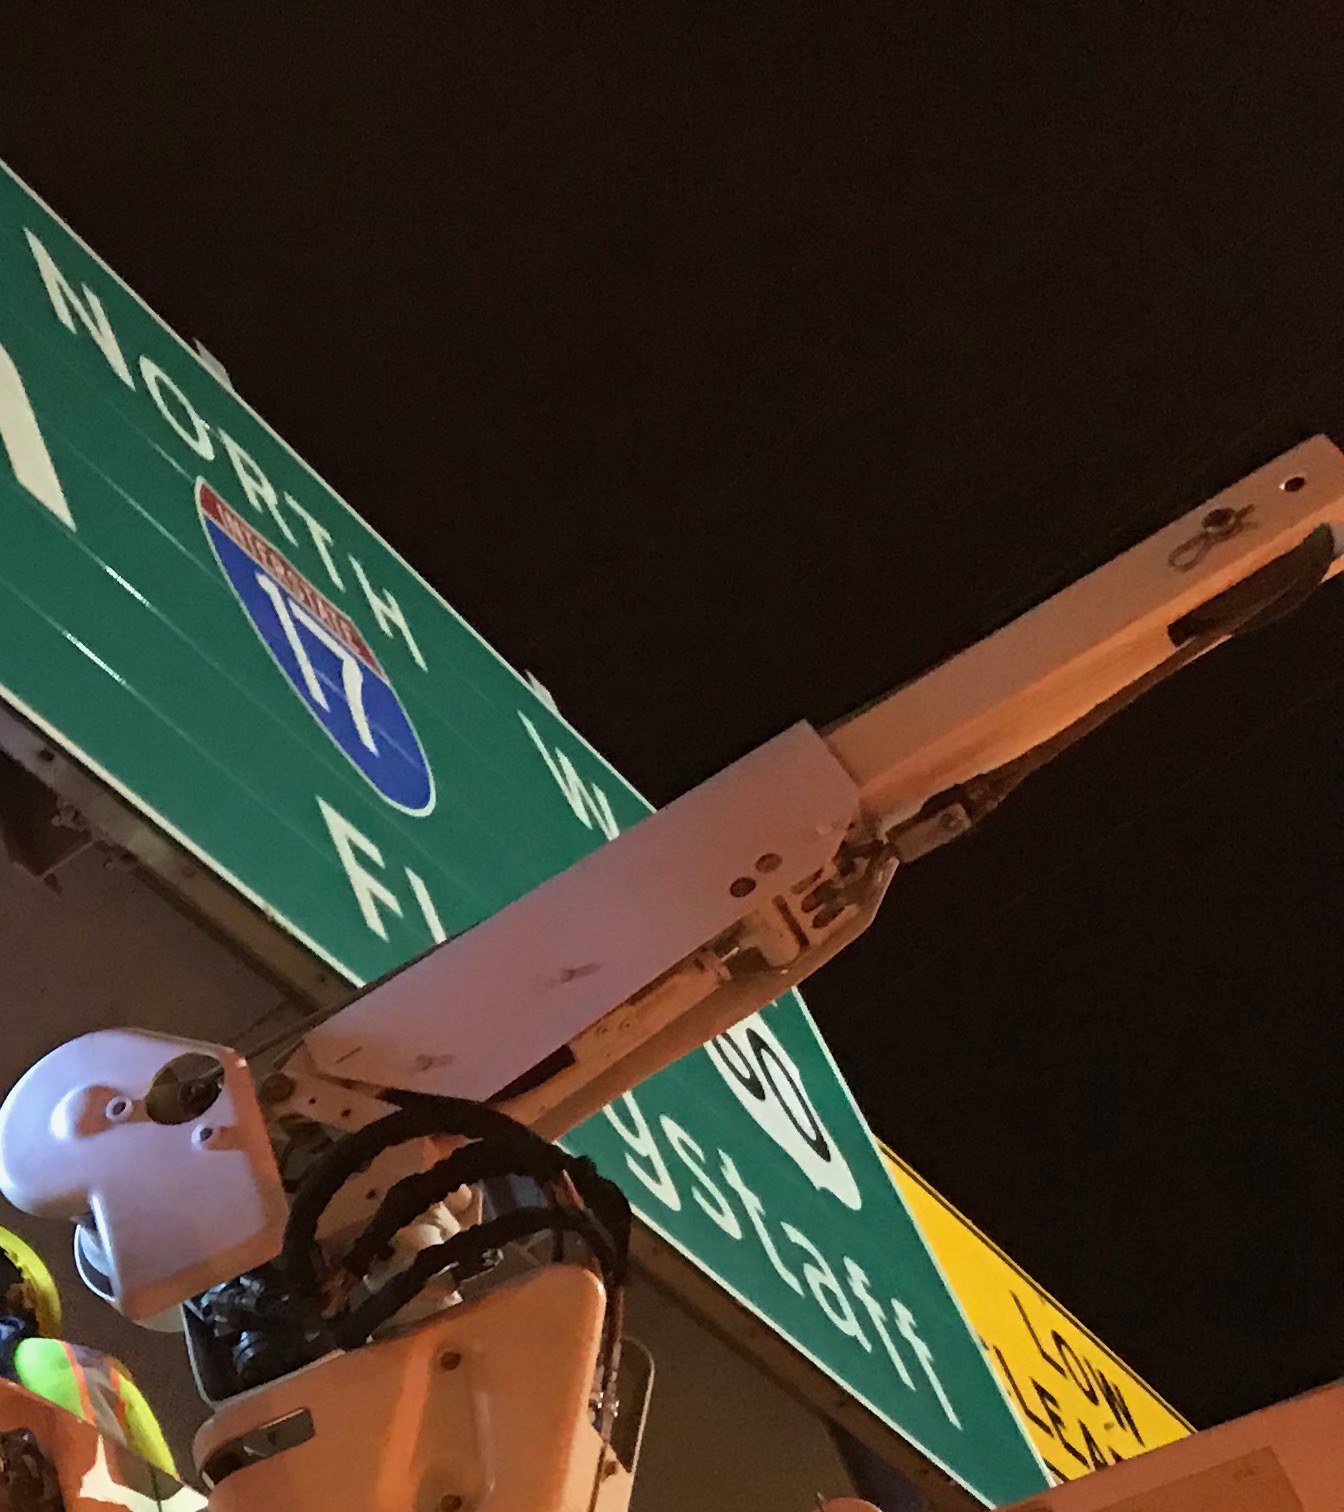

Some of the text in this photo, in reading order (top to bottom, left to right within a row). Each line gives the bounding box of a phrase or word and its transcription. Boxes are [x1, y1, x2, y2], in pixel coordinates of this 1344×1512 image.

[23, 226, 428, 673] NORTH
[255, 571, 378, 757] 17
[1009, 1289, 1146, 1448] LOW
